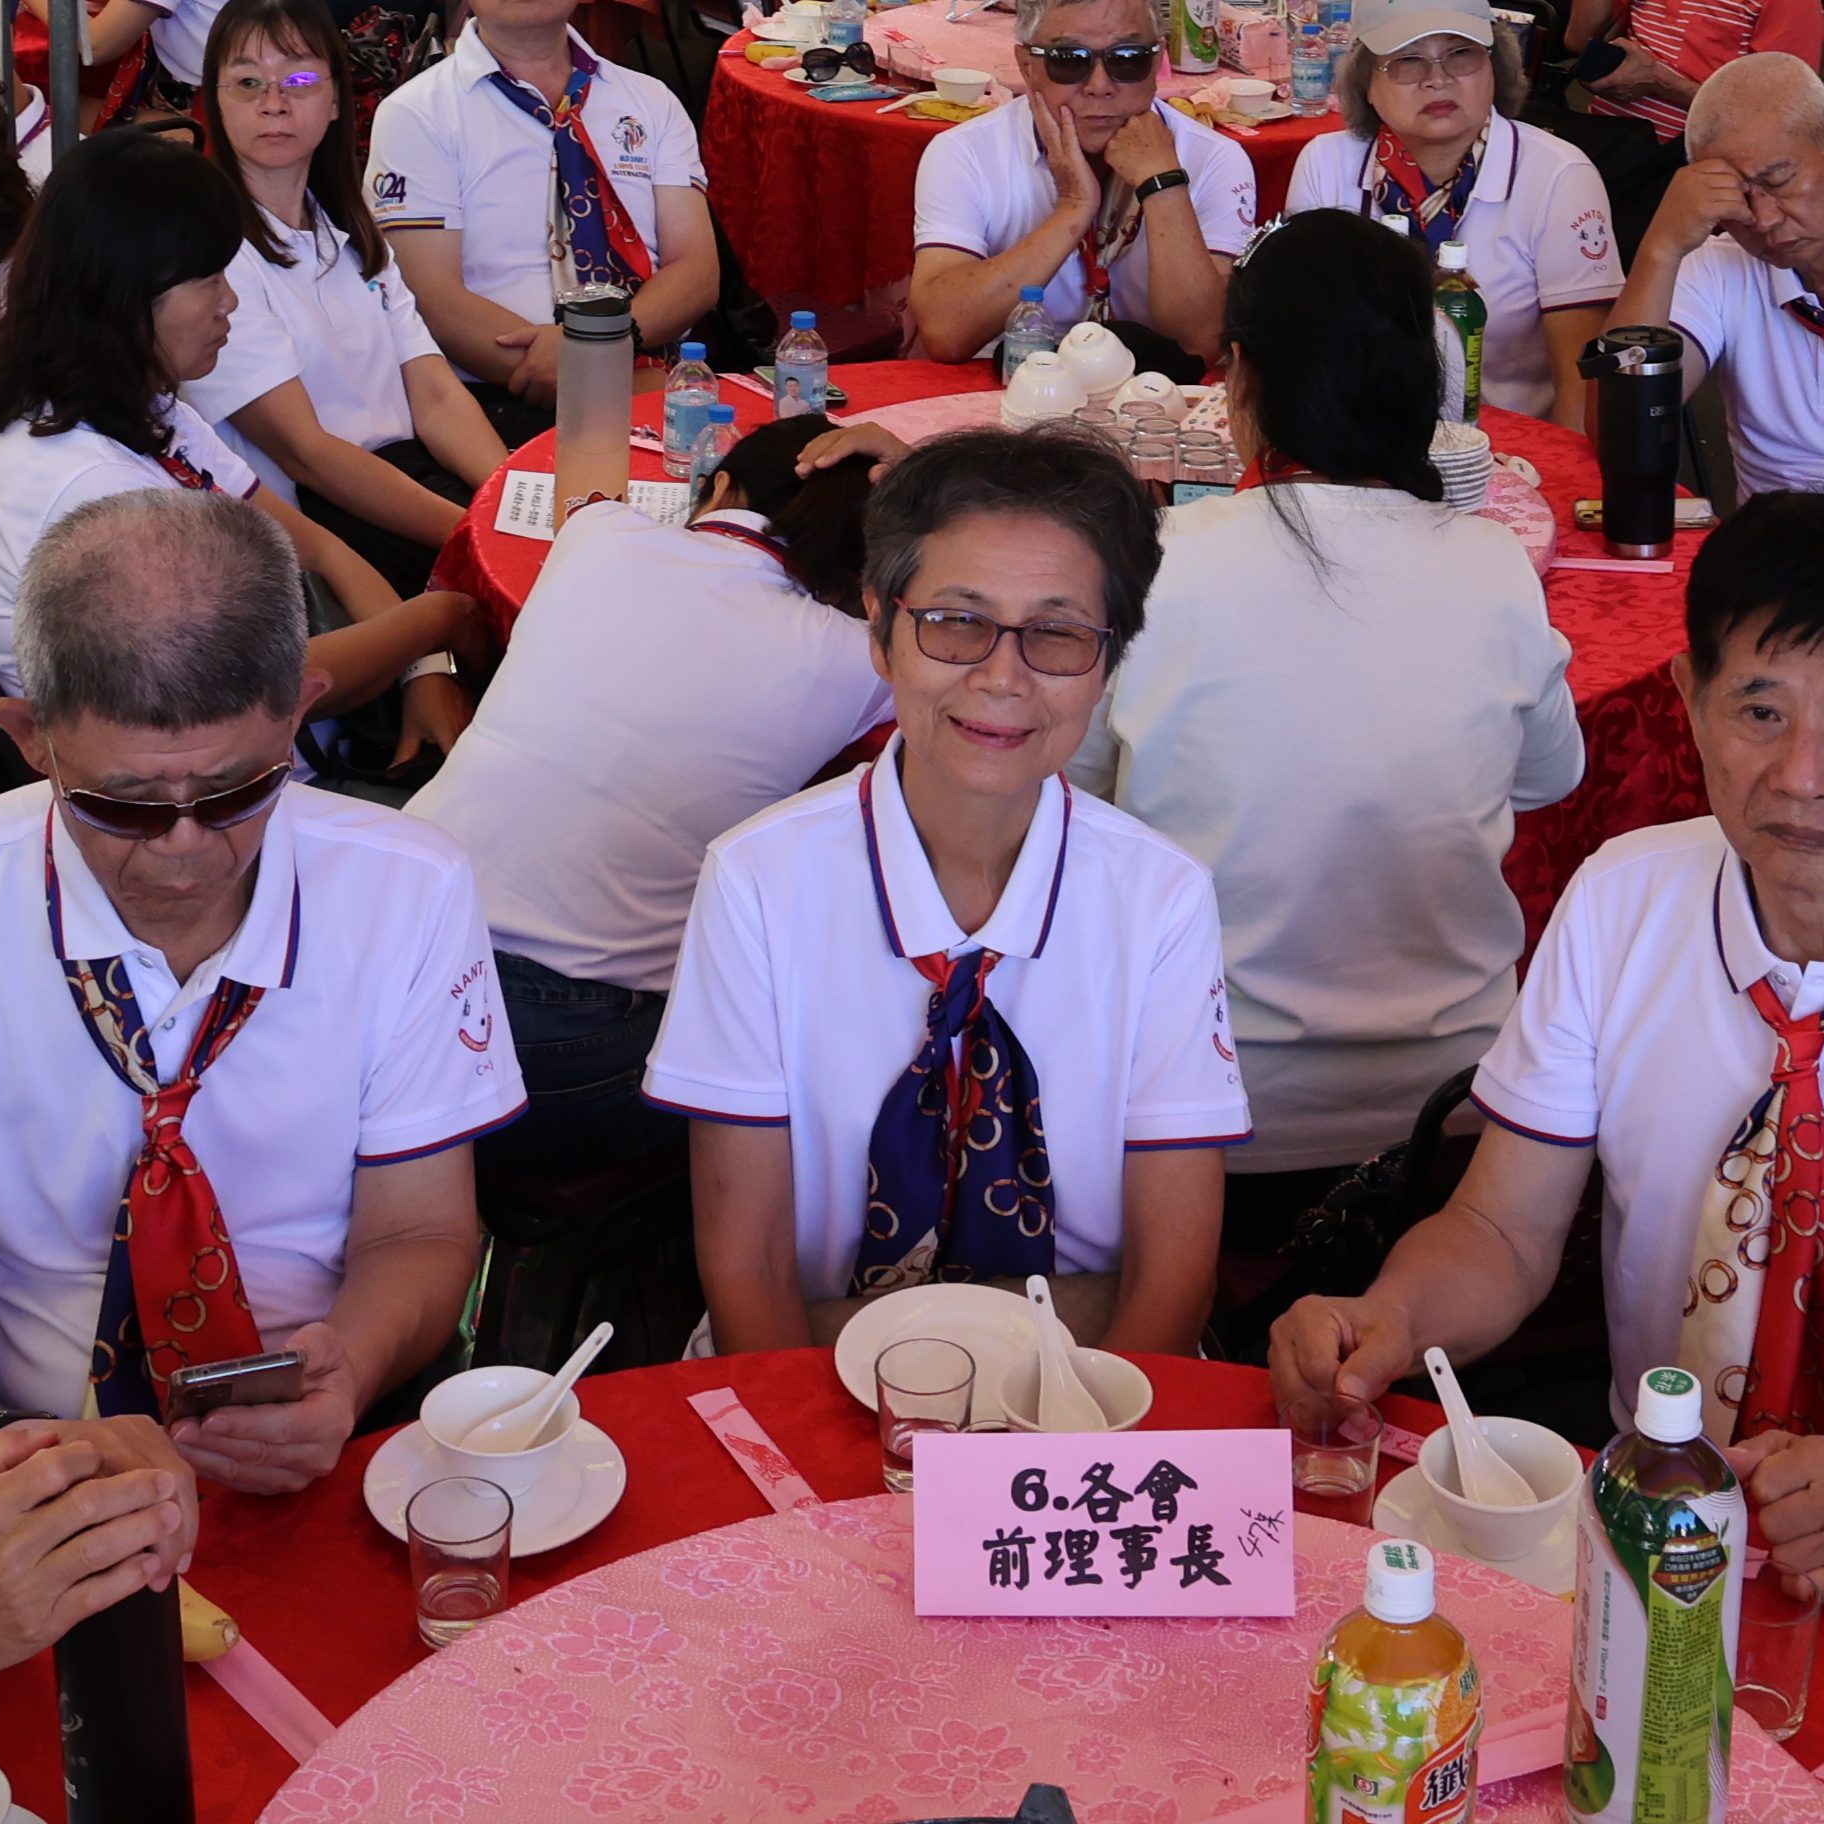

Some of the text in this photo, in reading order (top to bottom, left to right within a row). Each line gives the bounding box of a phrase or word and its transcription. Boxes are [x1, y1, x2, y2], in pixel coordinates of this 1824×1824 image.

[1011, 1460, 1198, 1524] 6.各會
[982, 1523, 1232, 1590] 前理事長
